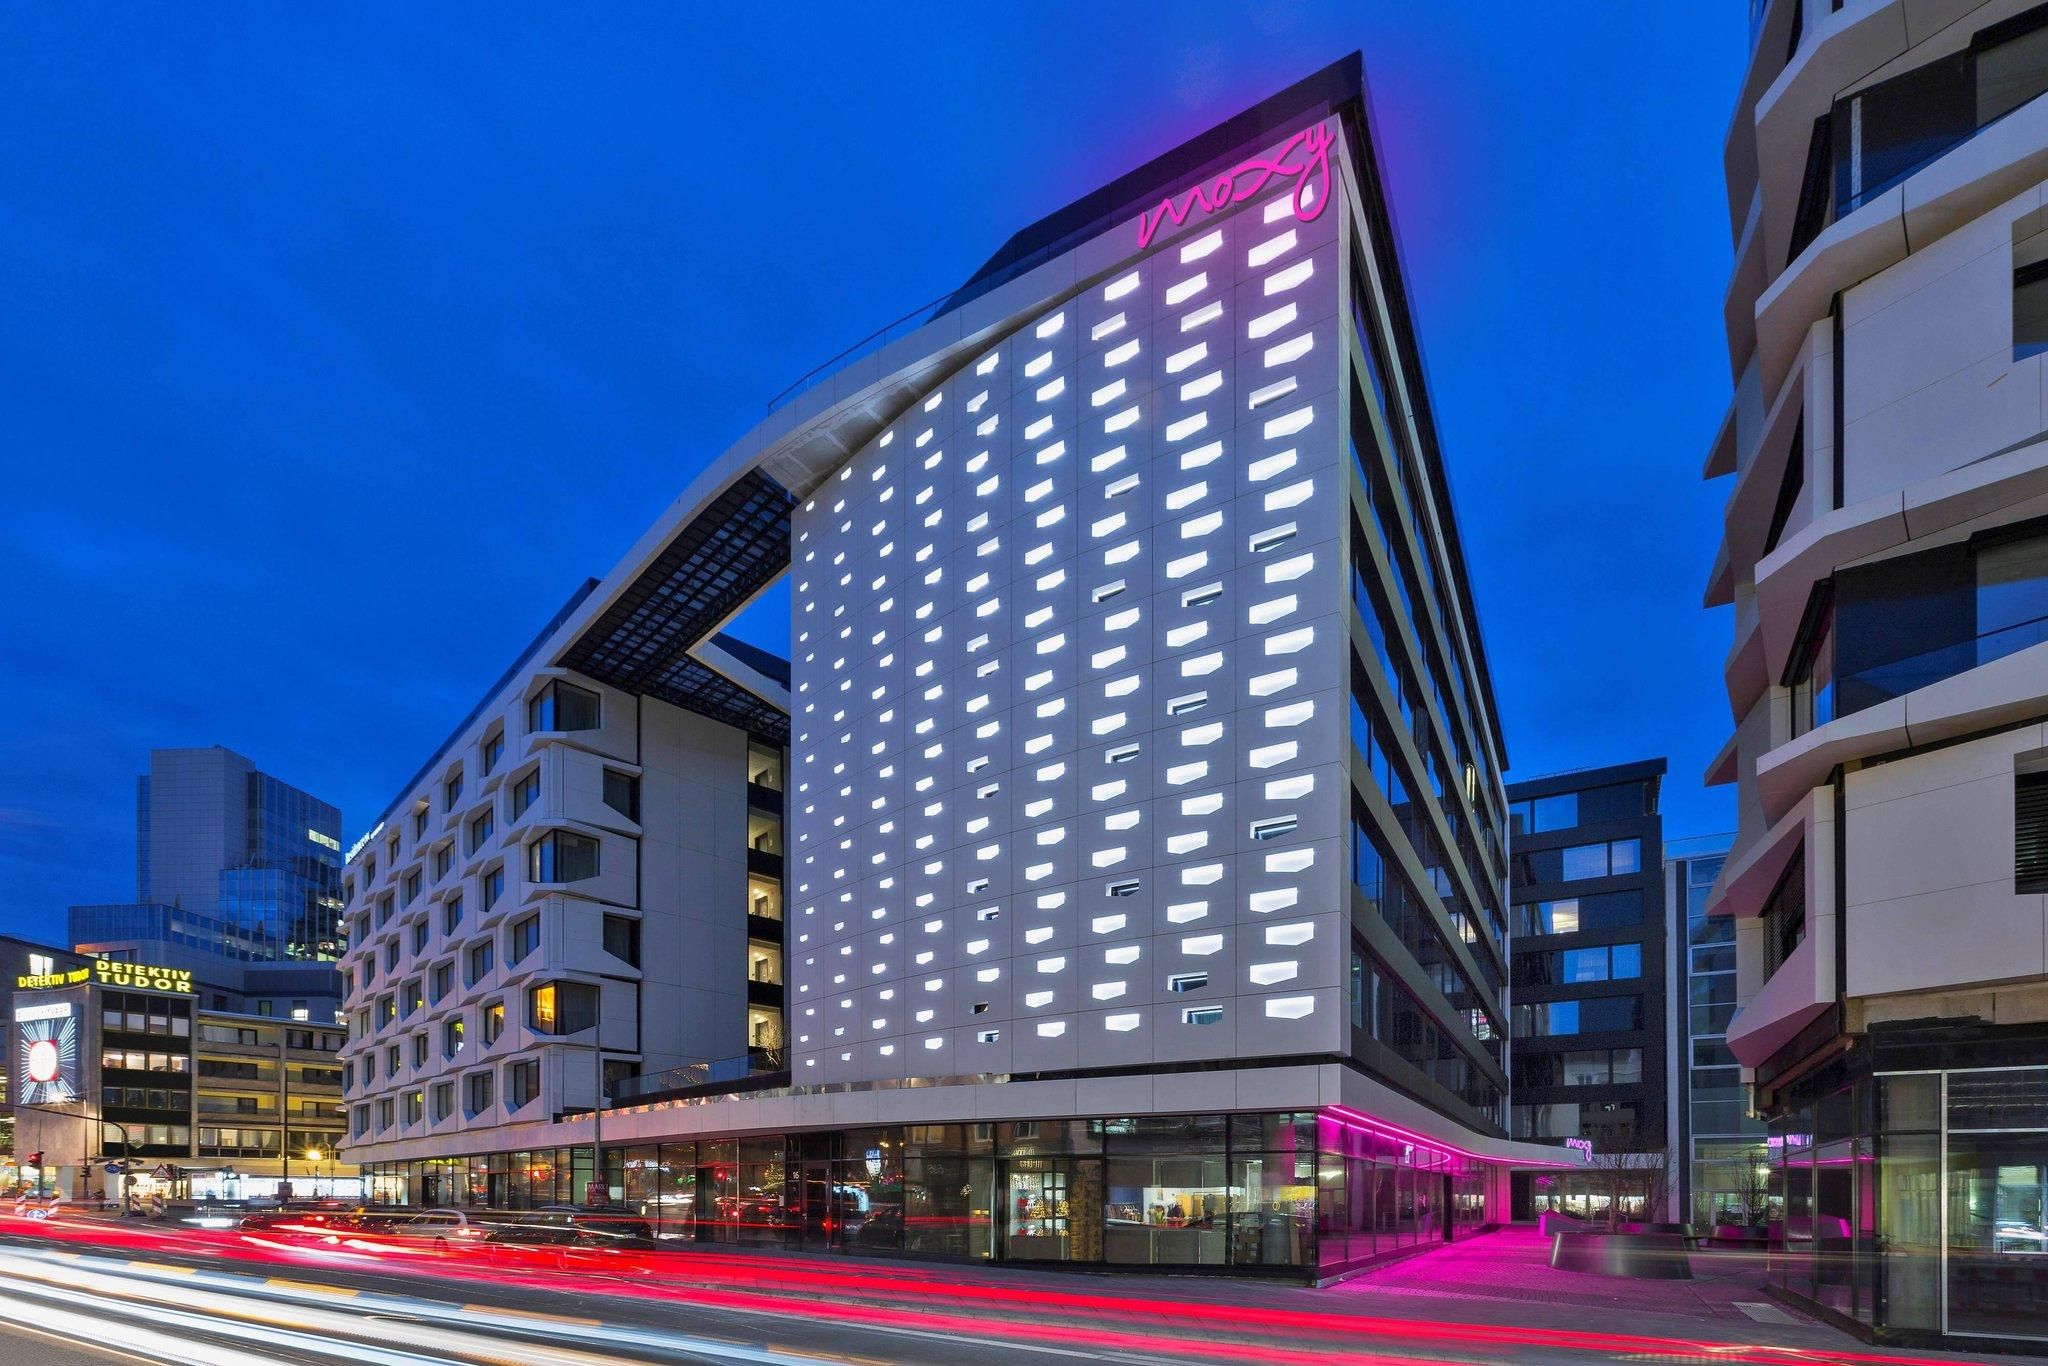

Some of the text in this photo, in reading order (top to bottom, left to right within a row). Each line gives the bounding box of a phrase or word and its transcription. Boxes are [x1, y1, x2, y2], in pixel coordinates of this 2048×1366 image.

[1137, 121, 1335, 249] moxy
[18, 968, 89, 988] DETEKTIV TUDOR
[96, 960, 191, 981] DETEKTIV
[97, 971, 191, 993] TUDOR
